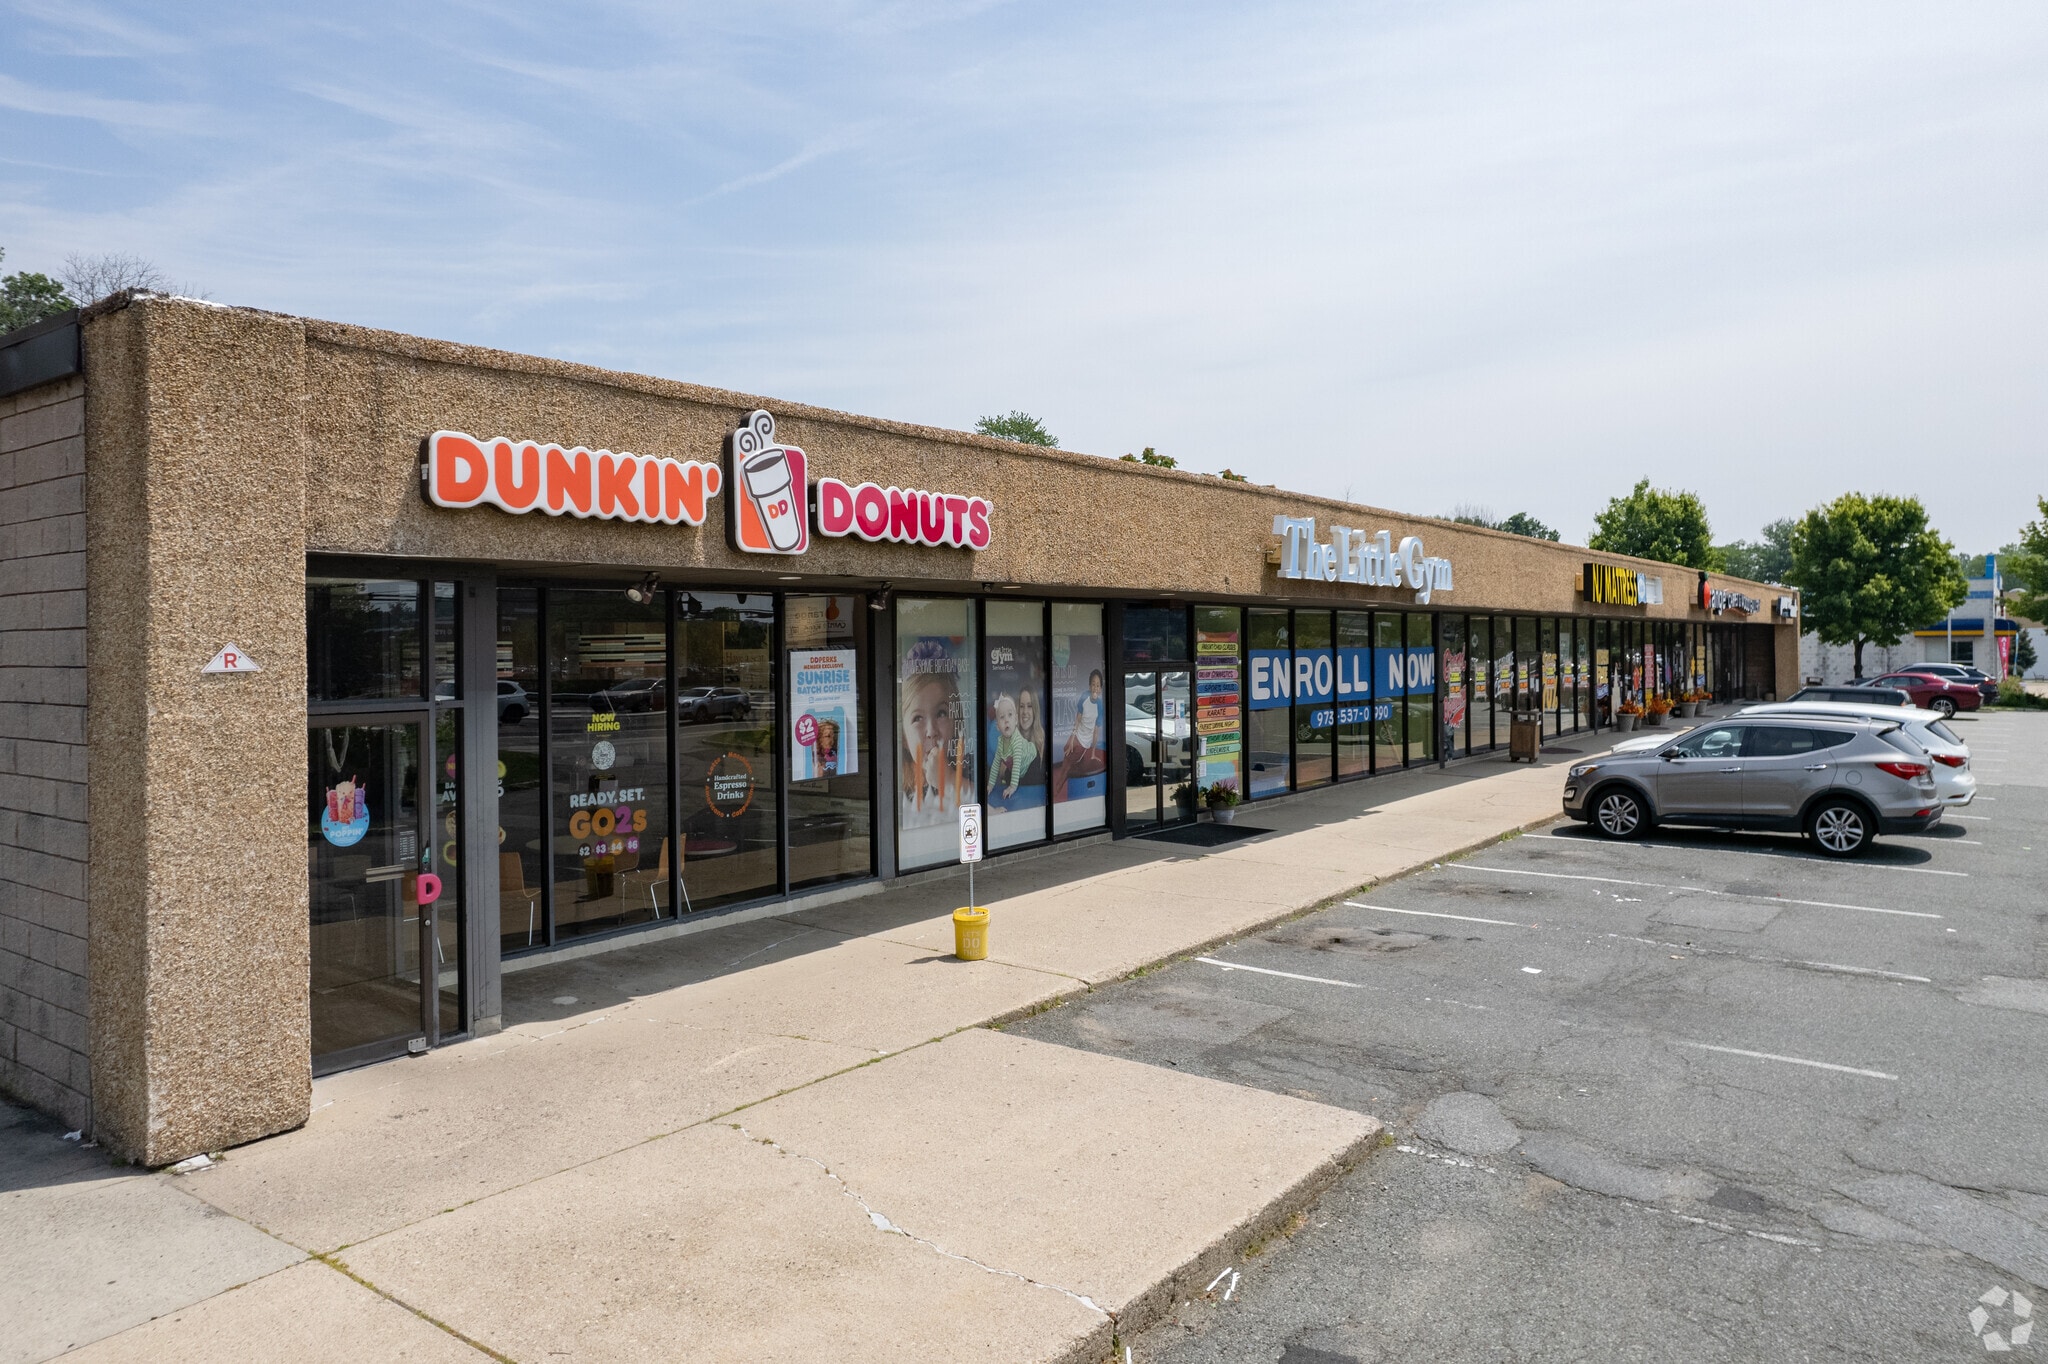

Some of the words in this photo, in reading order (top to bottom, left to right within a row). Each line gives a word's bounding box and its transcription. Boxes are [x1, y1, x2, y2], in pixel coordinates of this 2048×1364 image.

[436, 436, 720, 523] DUNKIN'
[822, 482, 989, 550] DONUTS
[769, 499, 788, 520] DD
[1273, 515, 1338, 582] The
[1332, 526, 1402, 588] Little
[1400, 536, 1454, 605] Gym
[1604, 565, 1638, 607] MATTRESS
[223, 652, 238, 669] R
[797, 669, 850, 686] SUNRISE
[1251, 654, 1369, 700] ENROLL
[1388, 652, 1436, 691] NOW!
[796, 686, 822, 695] BATCH
[823, 684, 850, 694] COFFEE
[591, 713, 616, 723] NOW
[1207, 708, 1227, 717] KARATE
[587, 721, 621, 732] HIRING
[799, 718, 815, 735] $2
[713, 773, 748, 782] Handcrafted
[713, 781, 748, 792] Espresso
[569, 790, 618, 809] READY.
[619, 787, 646, 803] SET.
[716, 790, 745, 801] Drinks
[578, 846, 591, 857] $2
[595, 844, 607, 854] $3
[416, 873, 442, 905] D
